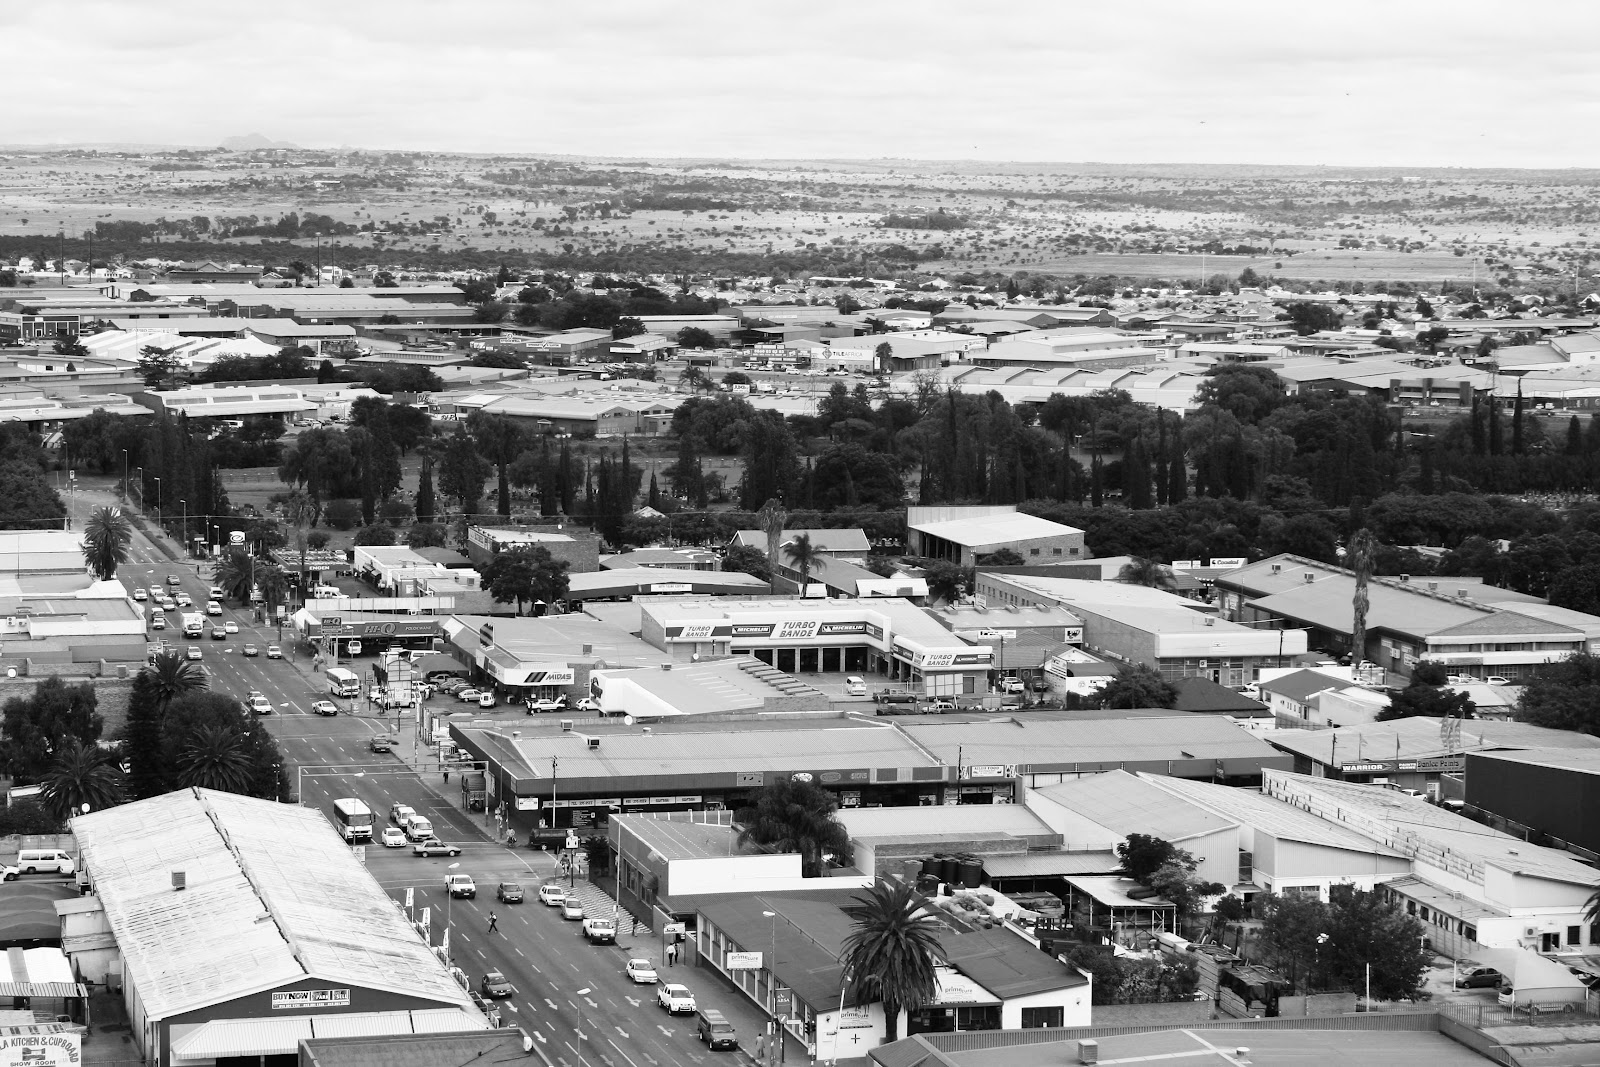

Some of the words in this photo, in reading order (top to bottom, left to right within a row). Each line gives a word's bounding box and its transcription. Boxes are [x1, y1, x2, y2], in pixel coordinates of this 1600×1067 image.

[364, 622, 397, 636] HI-Q
[782, 621, 816, 629] TURBO
[779, 629, 813, 638] BANDE
[11, 1037, 40, 1047] KITCHEN
[48, 1036, 79, 1063] CUPBOARD
